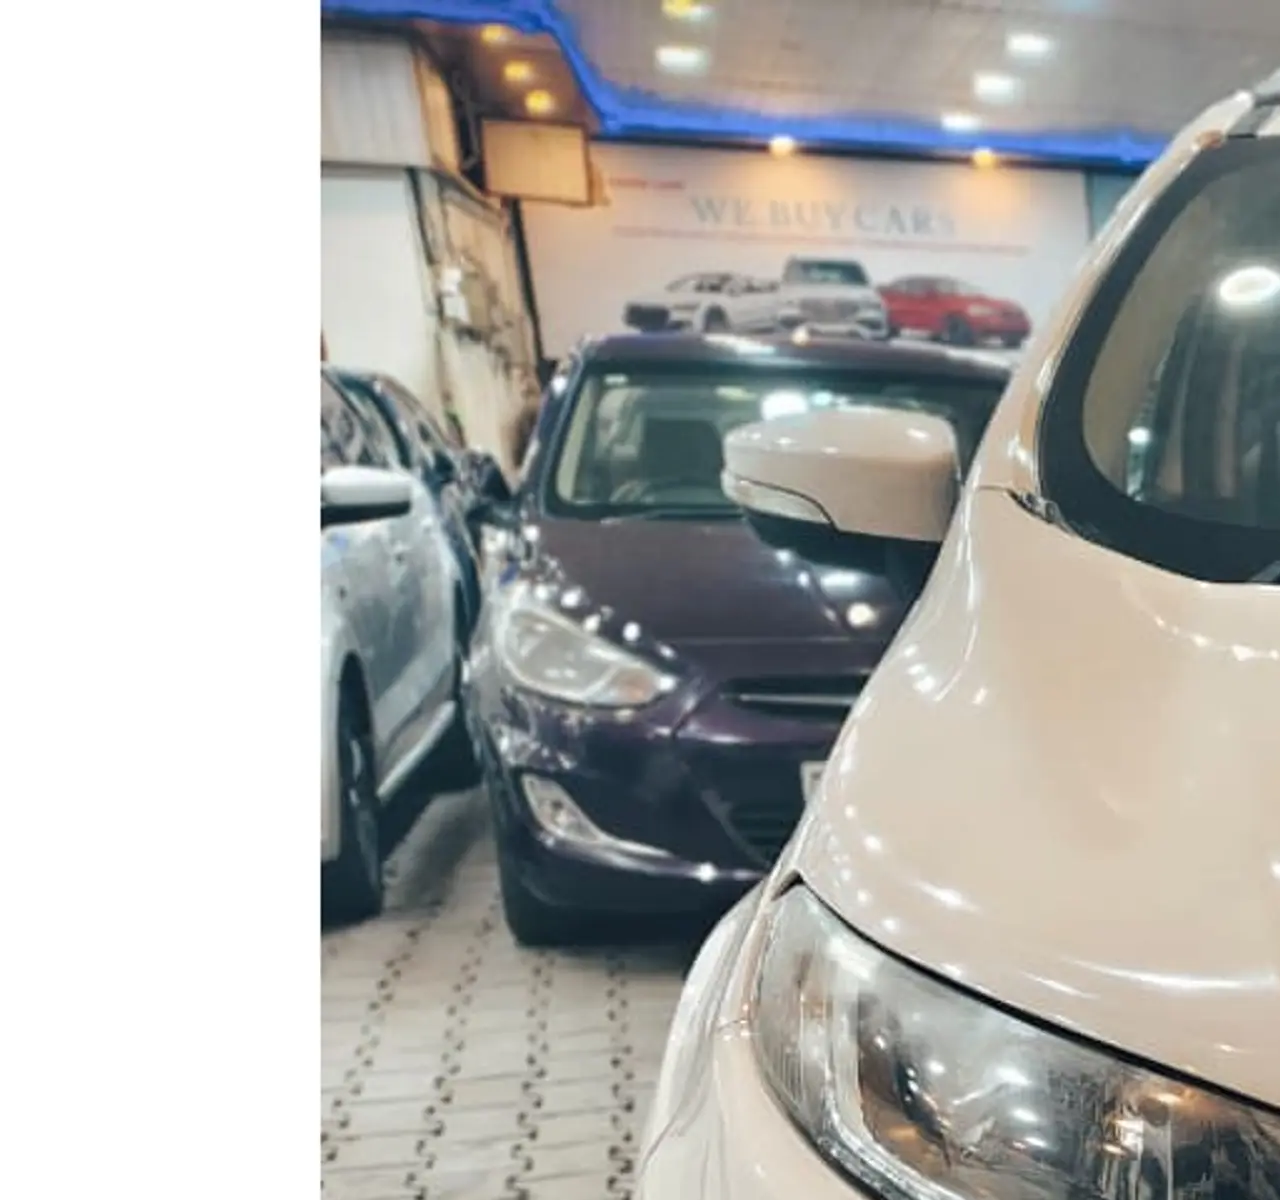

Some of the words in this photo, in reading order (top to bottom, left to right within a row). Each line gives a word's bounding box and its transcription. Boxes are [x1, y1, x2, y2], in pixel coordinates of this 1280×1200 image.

[691, 196, 755, 227] WE
[768, 198, 846, 231] BUY
[853, 202, 956, 236] CARS
